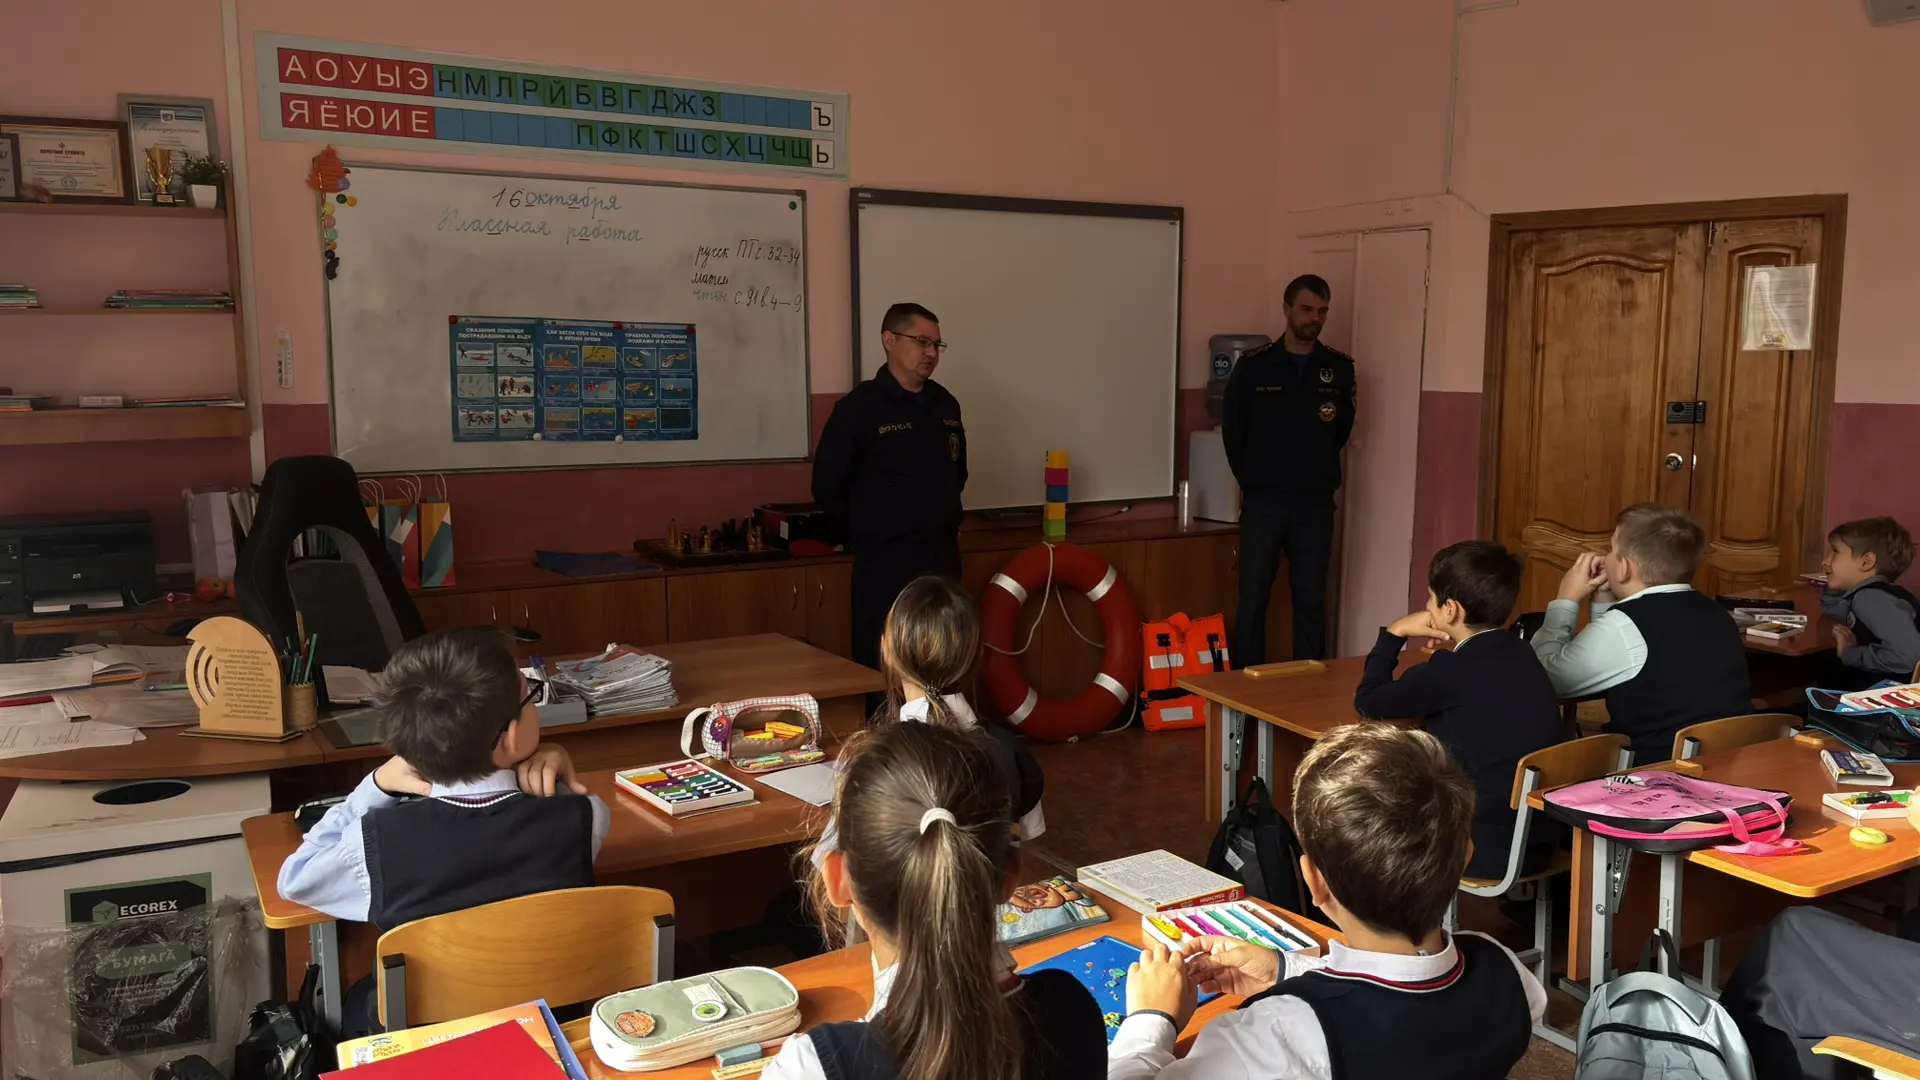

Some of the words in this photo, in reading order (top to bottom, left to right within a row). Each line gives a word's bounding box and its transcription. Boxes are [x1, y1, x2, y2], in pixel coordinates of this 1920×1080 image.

[492, 187, 524, 208] 16
[437, 204, 552, 235] Классная
[565, 218, 644, 245] работа
[120, 899, 178, 916] ECOREX
[113, 952, 176, 969] БУМАГА
